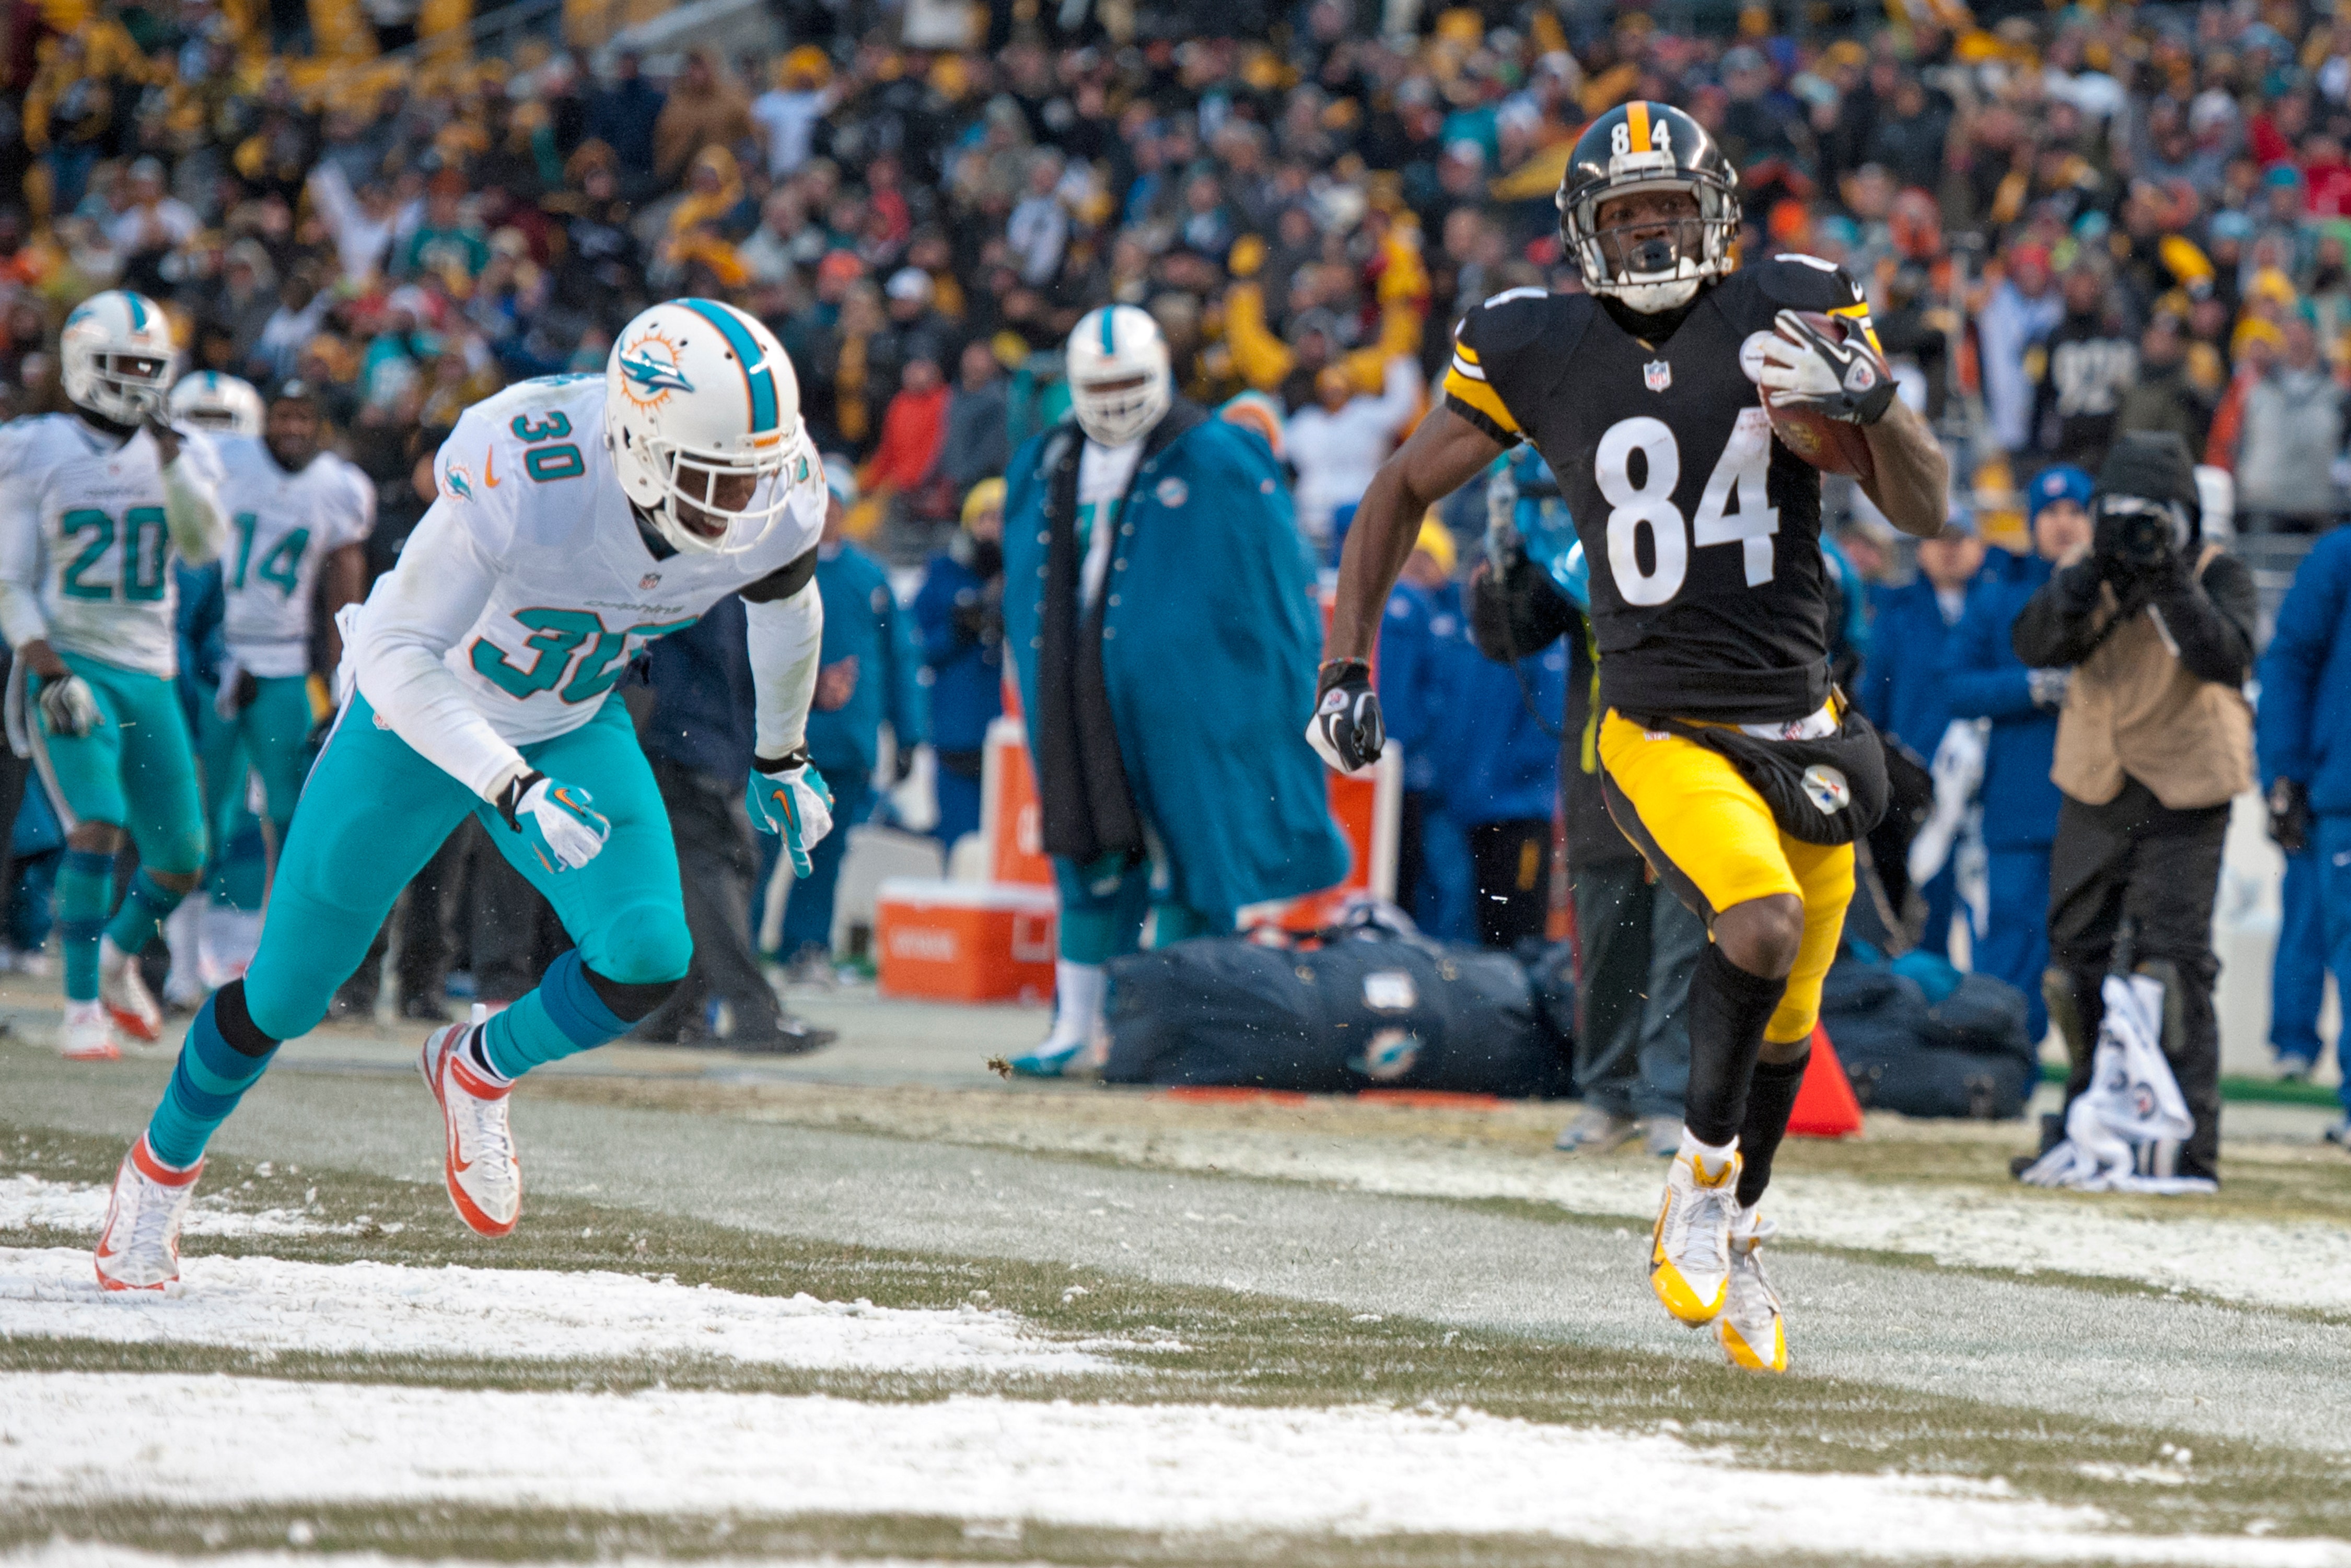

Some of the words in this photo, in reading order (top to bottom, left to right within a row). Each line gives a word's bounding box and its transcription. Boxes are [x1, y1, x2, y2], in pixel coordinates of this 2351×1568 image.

[509, 409, 586, 483] 30
[1595, 406, 1780, 606] 84
[60, 506, 170, 602] 20
[230, 510, 309, 601] 14
